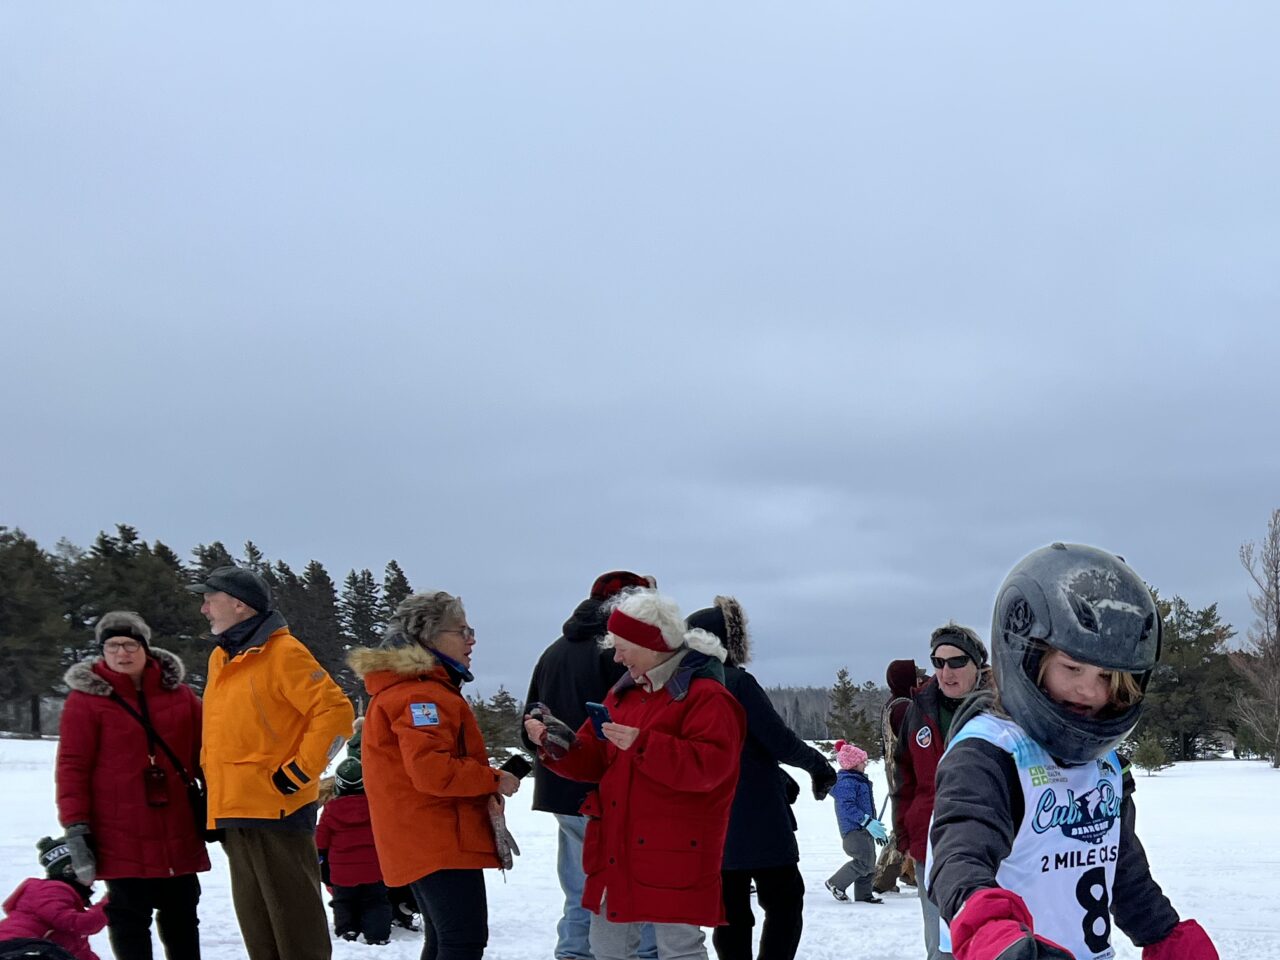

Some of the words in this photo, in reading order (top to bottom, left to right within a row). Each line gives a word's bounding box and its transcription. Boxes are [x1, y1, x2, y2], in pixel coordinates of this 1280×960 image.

[1032, 787, 1082, 834] Cub
[1041, 856, 1050, 873] 2
[1055, 849, 1096, 870] MILE
[1076, 867, 1111, 954] 8
